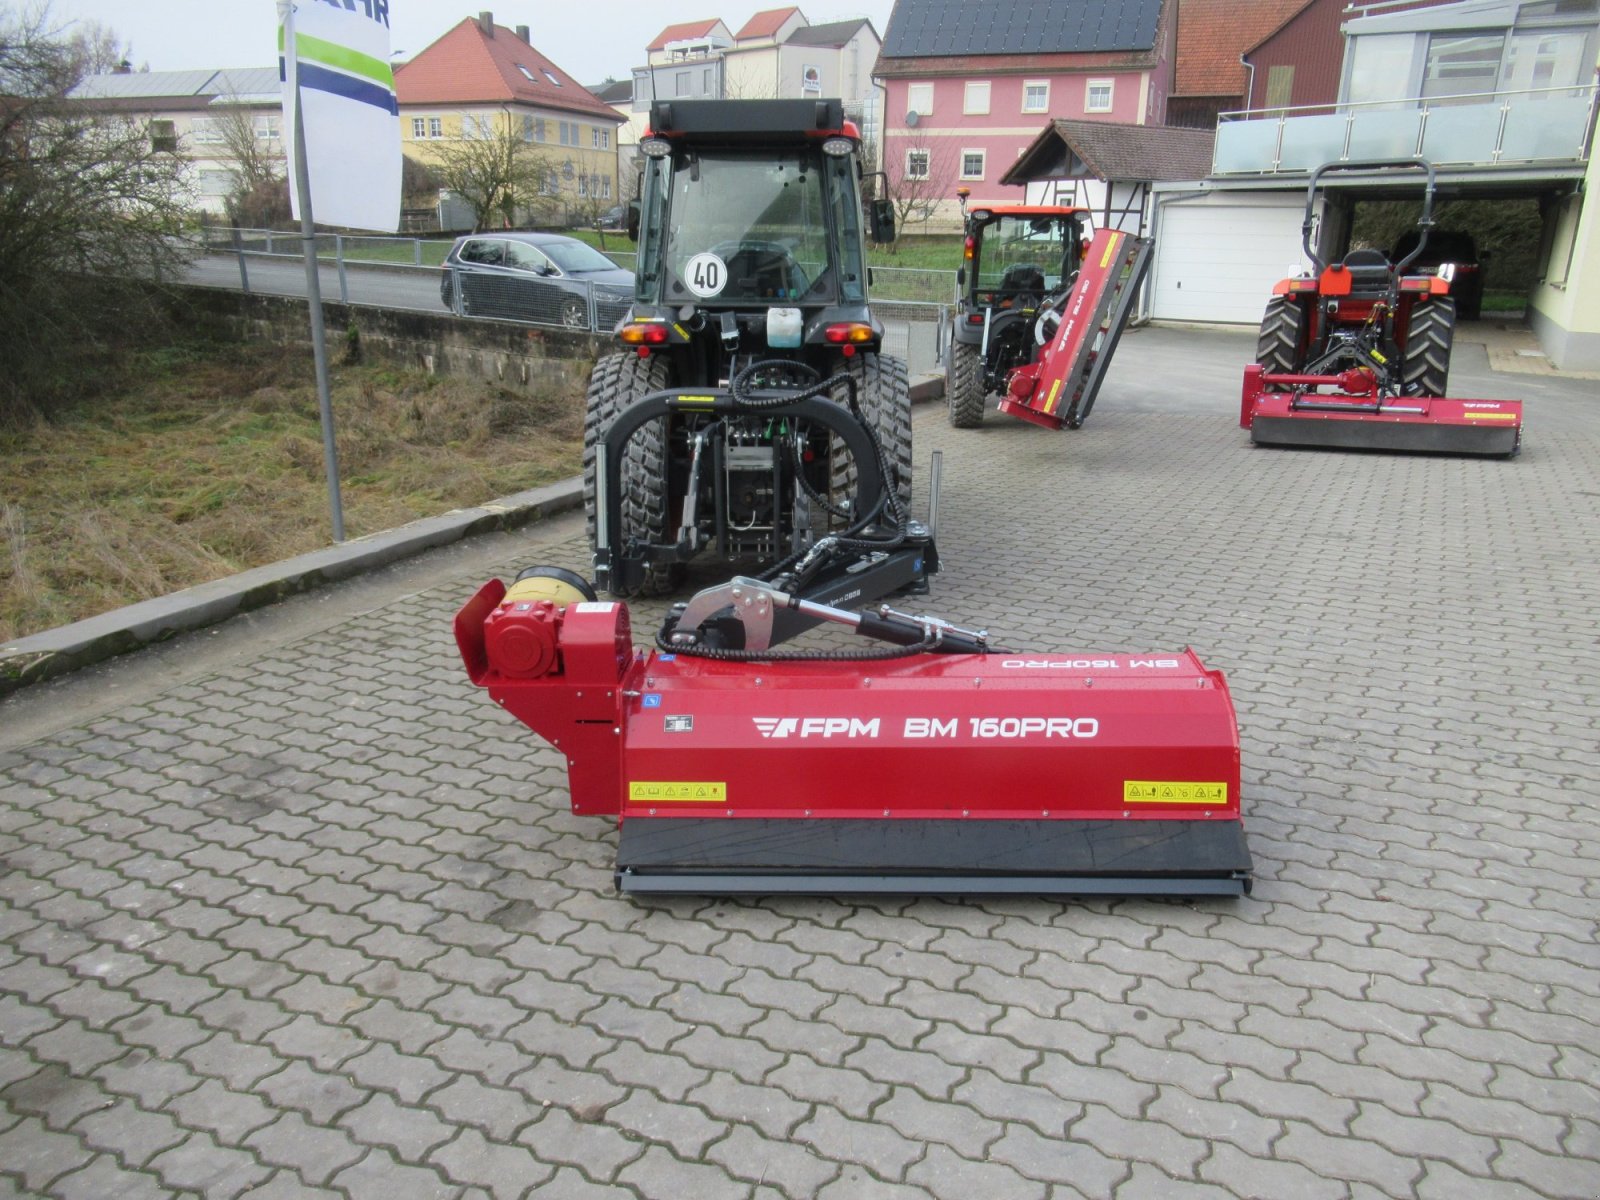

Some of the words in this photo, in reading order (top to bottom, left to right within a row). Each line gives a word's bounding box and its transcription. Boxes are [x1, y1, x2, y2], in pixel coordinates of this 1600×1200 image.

[694, 262, 718, 289] 40
[1002, 660, 1119, 668] 160PRO
[1130, 660, 1179, 668] BM
[801, 718, 880, 738] FPM
[904, 718, 958, 738] BM
[970, 718, 1099, 738] 160PRO
